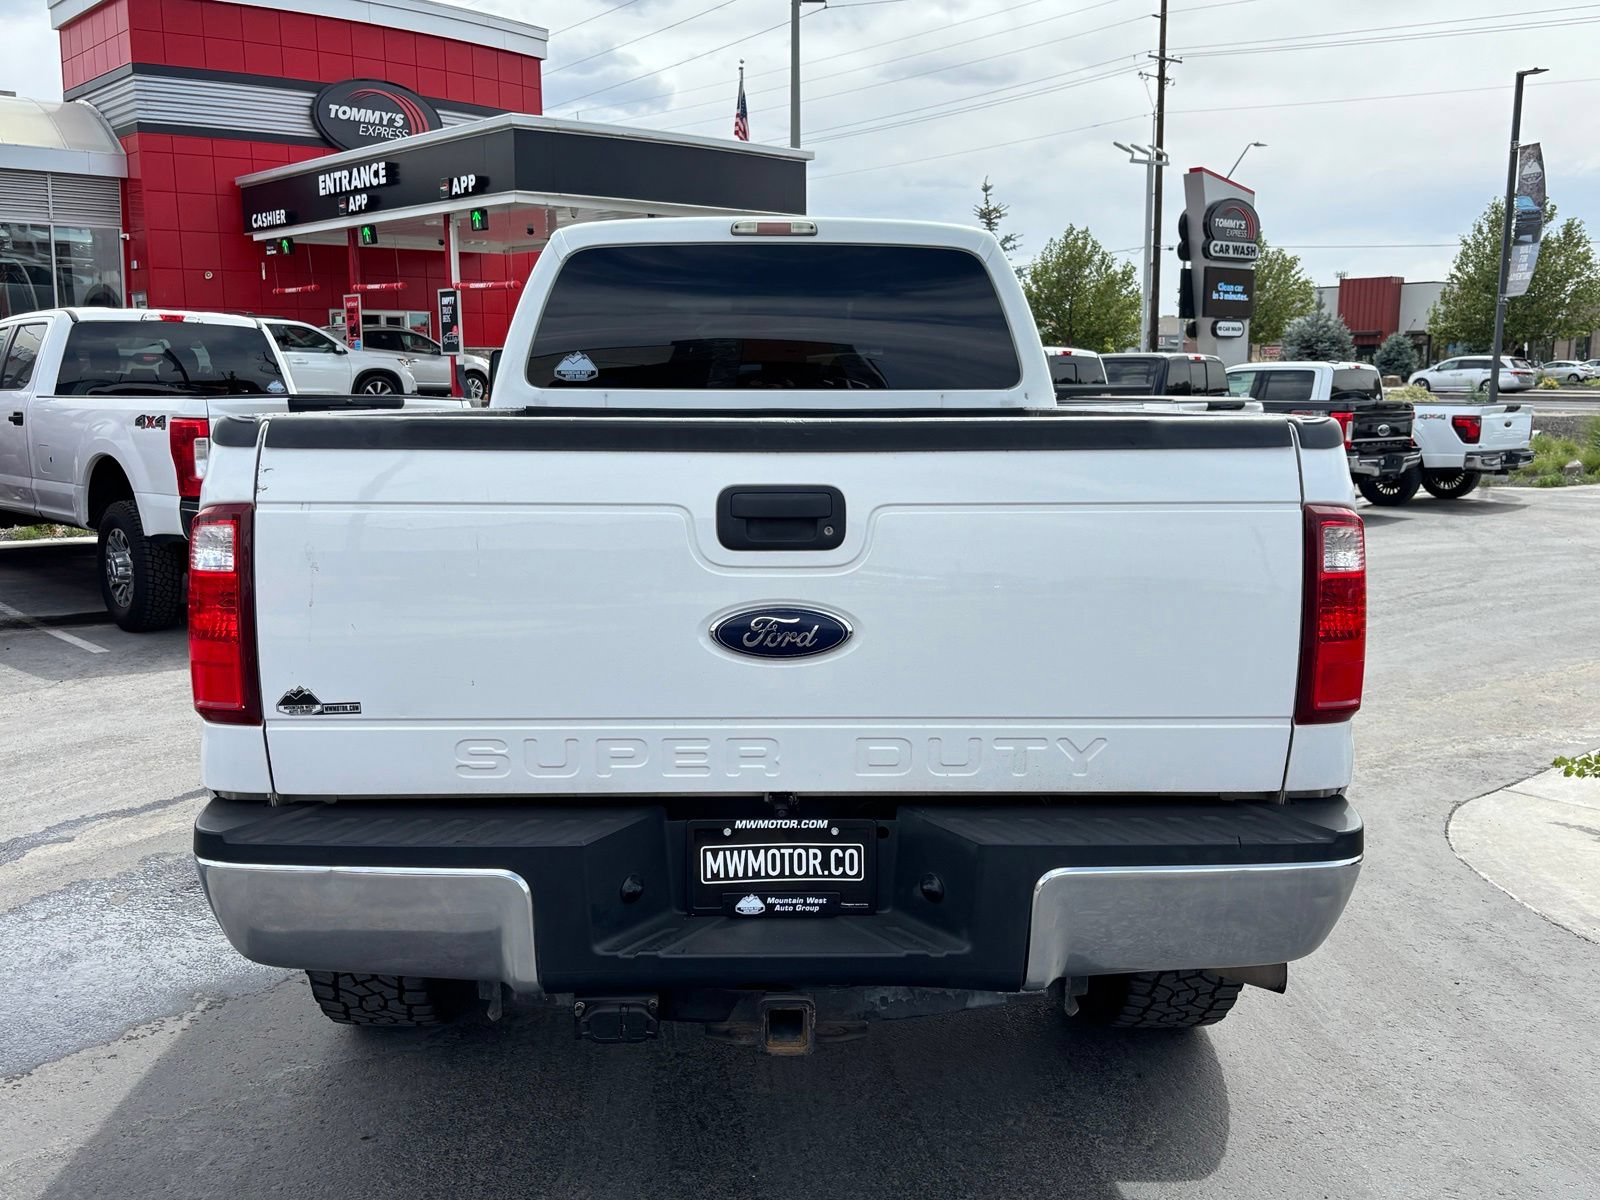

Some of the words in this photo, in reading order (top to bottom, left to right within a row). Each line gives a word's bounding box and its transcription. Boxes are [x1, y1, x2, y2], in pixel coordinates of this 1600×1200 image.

[328, 104, 404, 127] TOMMY'S
[359, 124, 409, 140] EXPRESS
[318, 161, 387, 196] ENTRANCE
[451, 173, 476, 195] APP
[348, 193, 368, 213] APP
[251, 209, 287, 228] CASHIER
[1215, 218, 1246, 229] TOMMY'S
[1226, 228, 1248, 238] EXPRESS
[1212, 243, 1230, 255] CAR
[1232, 244, 1257, 257] WASH
[1217, 282, 1234, 292] Clean
[441, 296, 455, 305] EMPTY
[742, 616, 820, 647] Ford
[454, 737, 781, 779] SUPER
[854, 736, 1109, 777] DUTY
[734, 819, 829, 829] MWMOTOR.COM
[705, 848, 859, 879] MWMOTOR.CO
[766, 896, 804, 904] Mountain
[806, 896, 828, 904] West
[774, 904, 793, 912] Auto
[795, 904, 820, 913] Group
